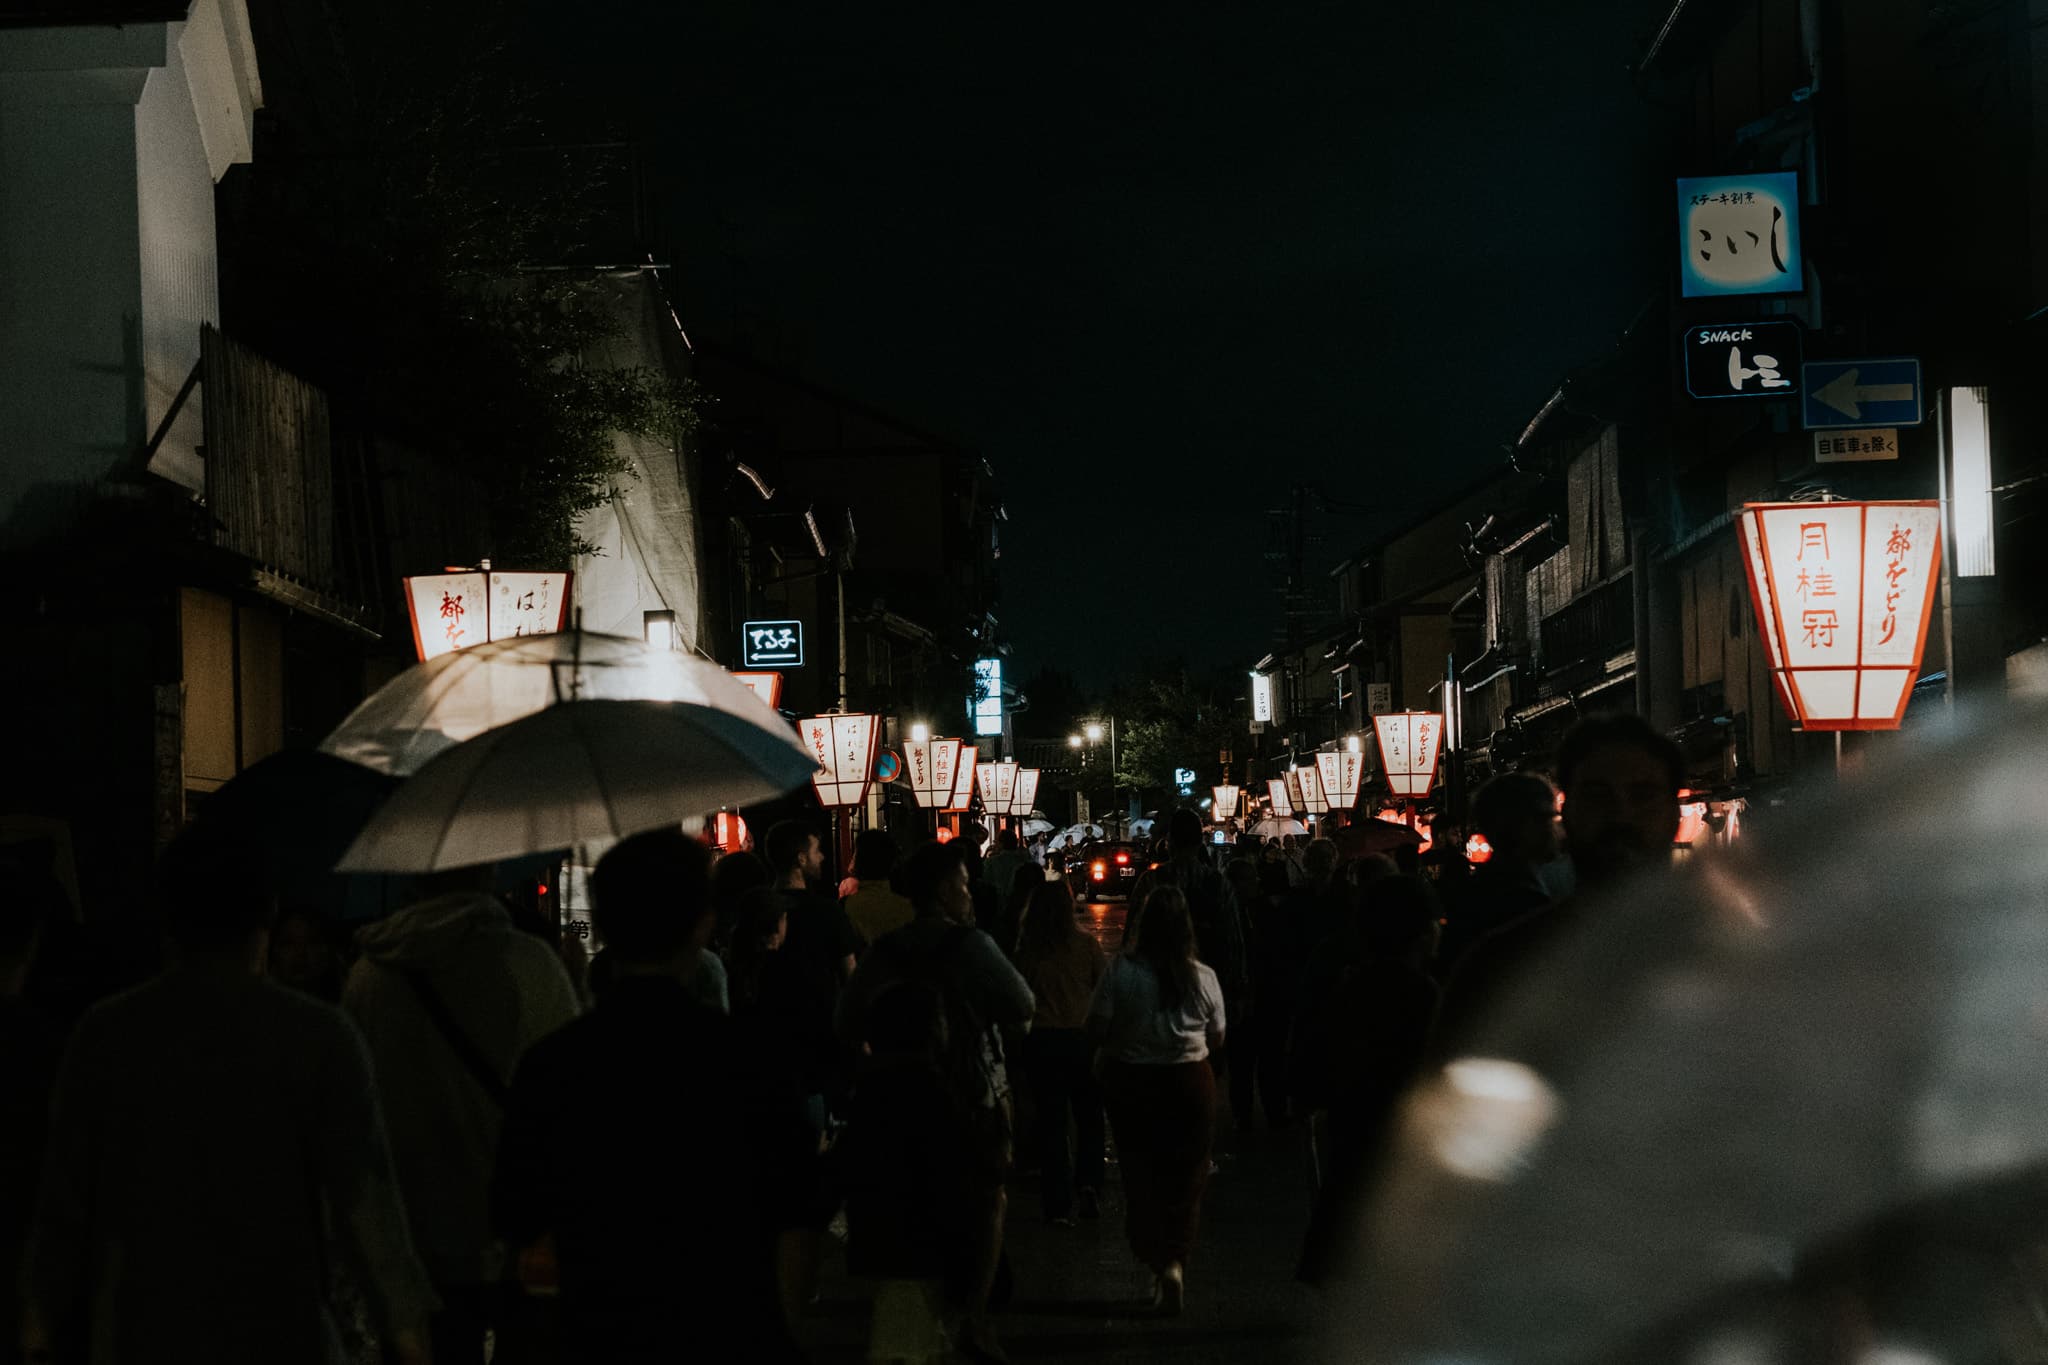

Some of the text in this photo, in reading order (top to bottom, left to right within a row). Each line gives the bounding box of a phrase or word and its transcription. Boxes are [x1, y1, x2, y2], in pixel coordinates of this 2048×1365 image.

[1690, 191, 1755, 207] ステーキ割烹
[1699, 206, 1787, 274] こいし
[1698, 329, 1752, 344] SNACK
[1729, 346, 1790, 391] トミ
[1818, 437, 1895, 455] 自転車を除く
[1795, 521, 1840, 649] 月桂冠
[1878, 522, 1912, 646] 都をどり
[570, 919, 591, 940] 第
